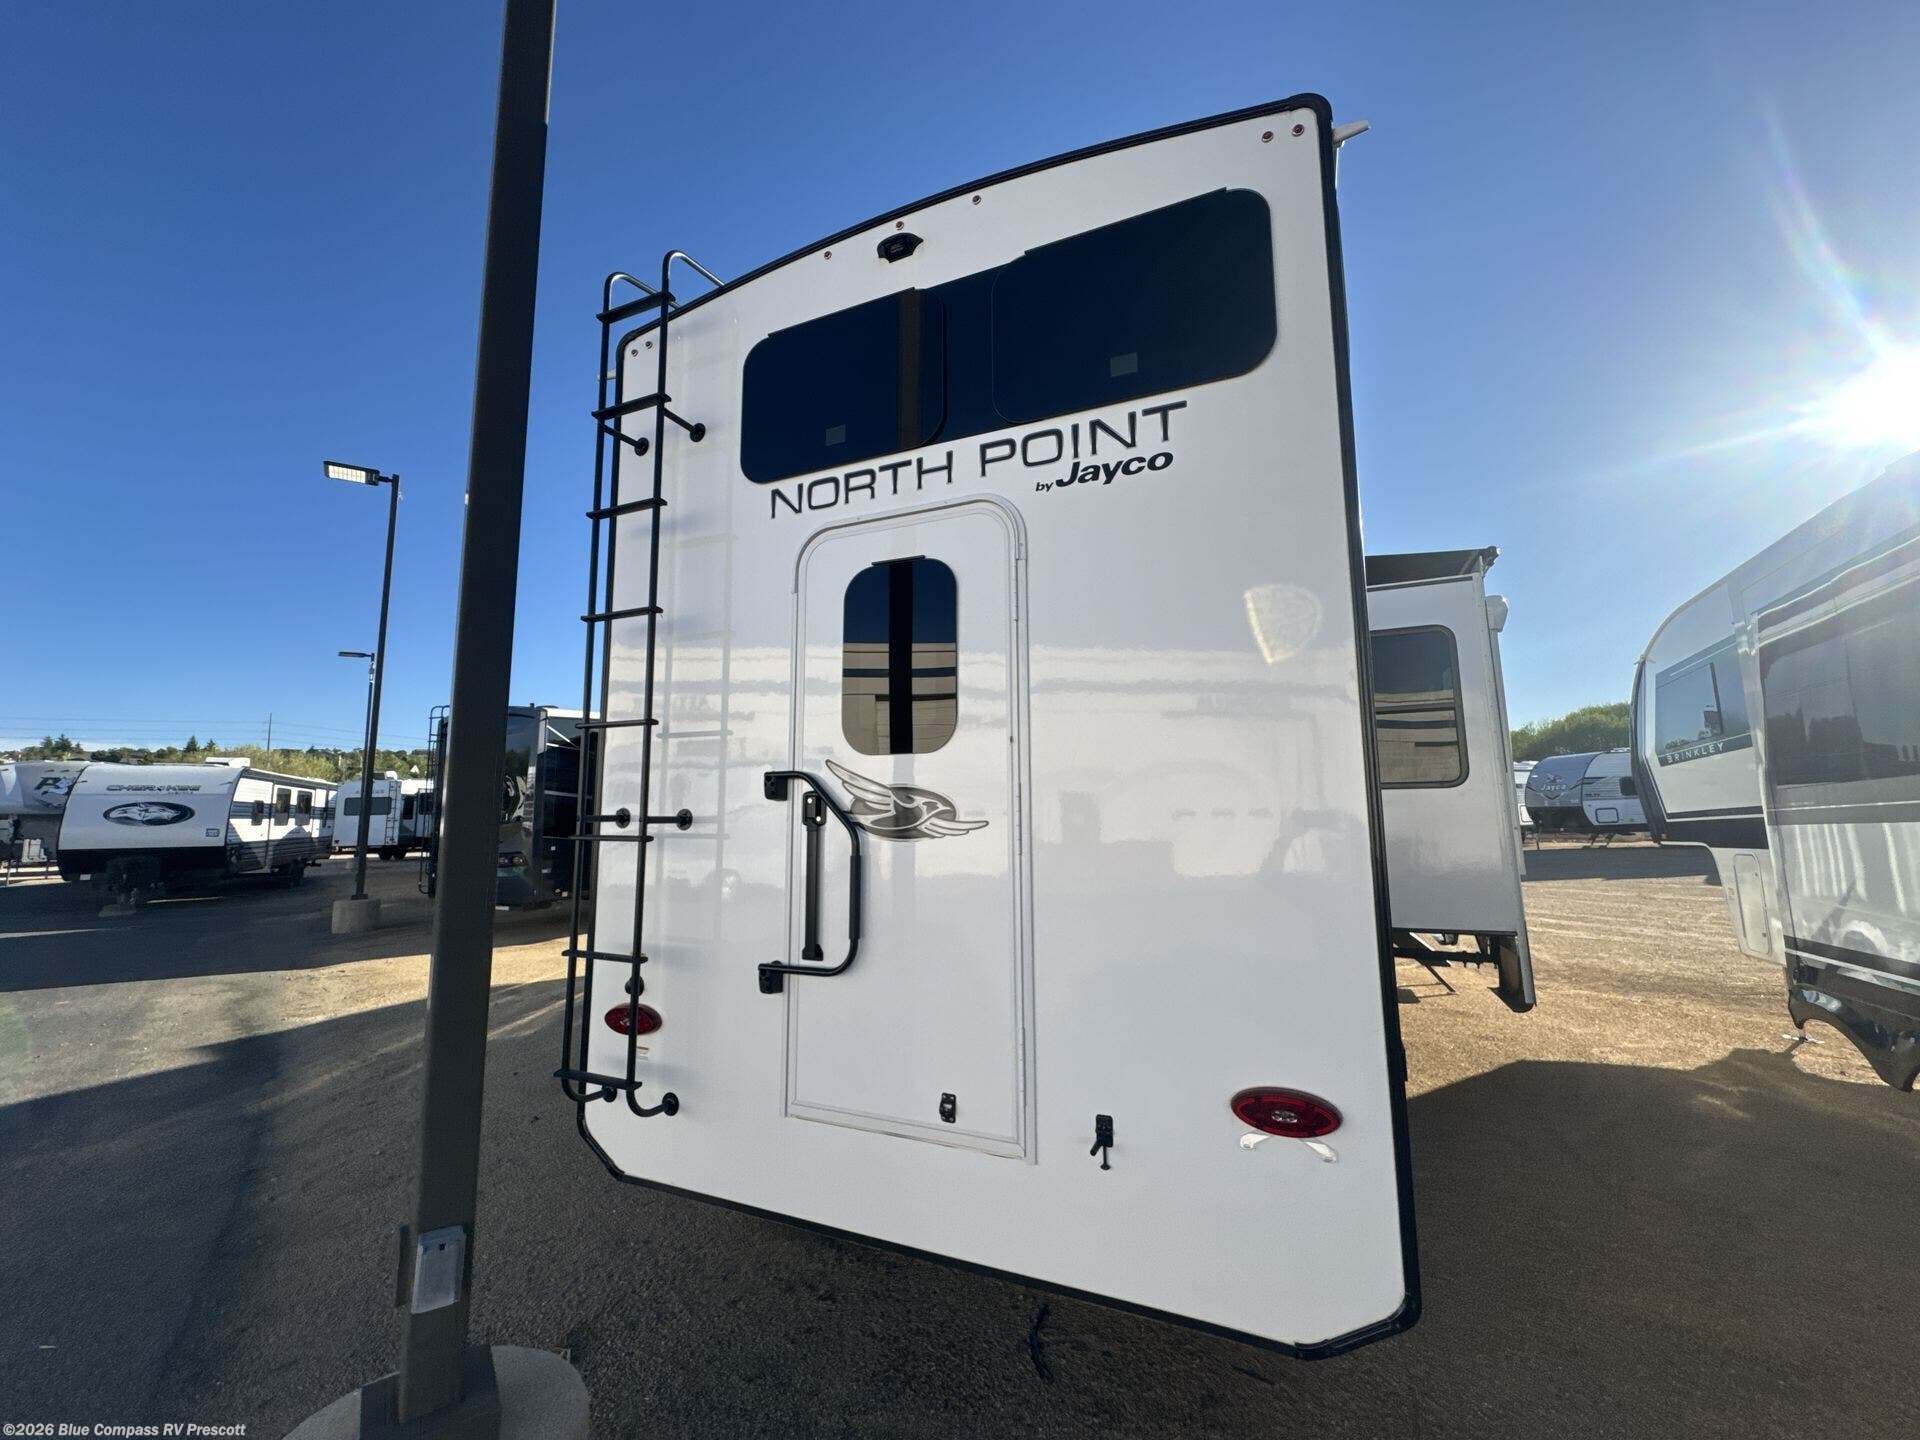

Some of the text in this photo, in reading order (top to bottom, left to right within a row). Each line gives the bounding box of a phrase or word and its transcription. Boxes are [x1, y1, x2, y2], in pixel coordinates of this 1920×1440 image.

[770, 400, 1188, 519] NORTH POINT
[1035, 451, 1174, 493] by Jayco
[1666, 742, 1724, 763] BRINKLEY
